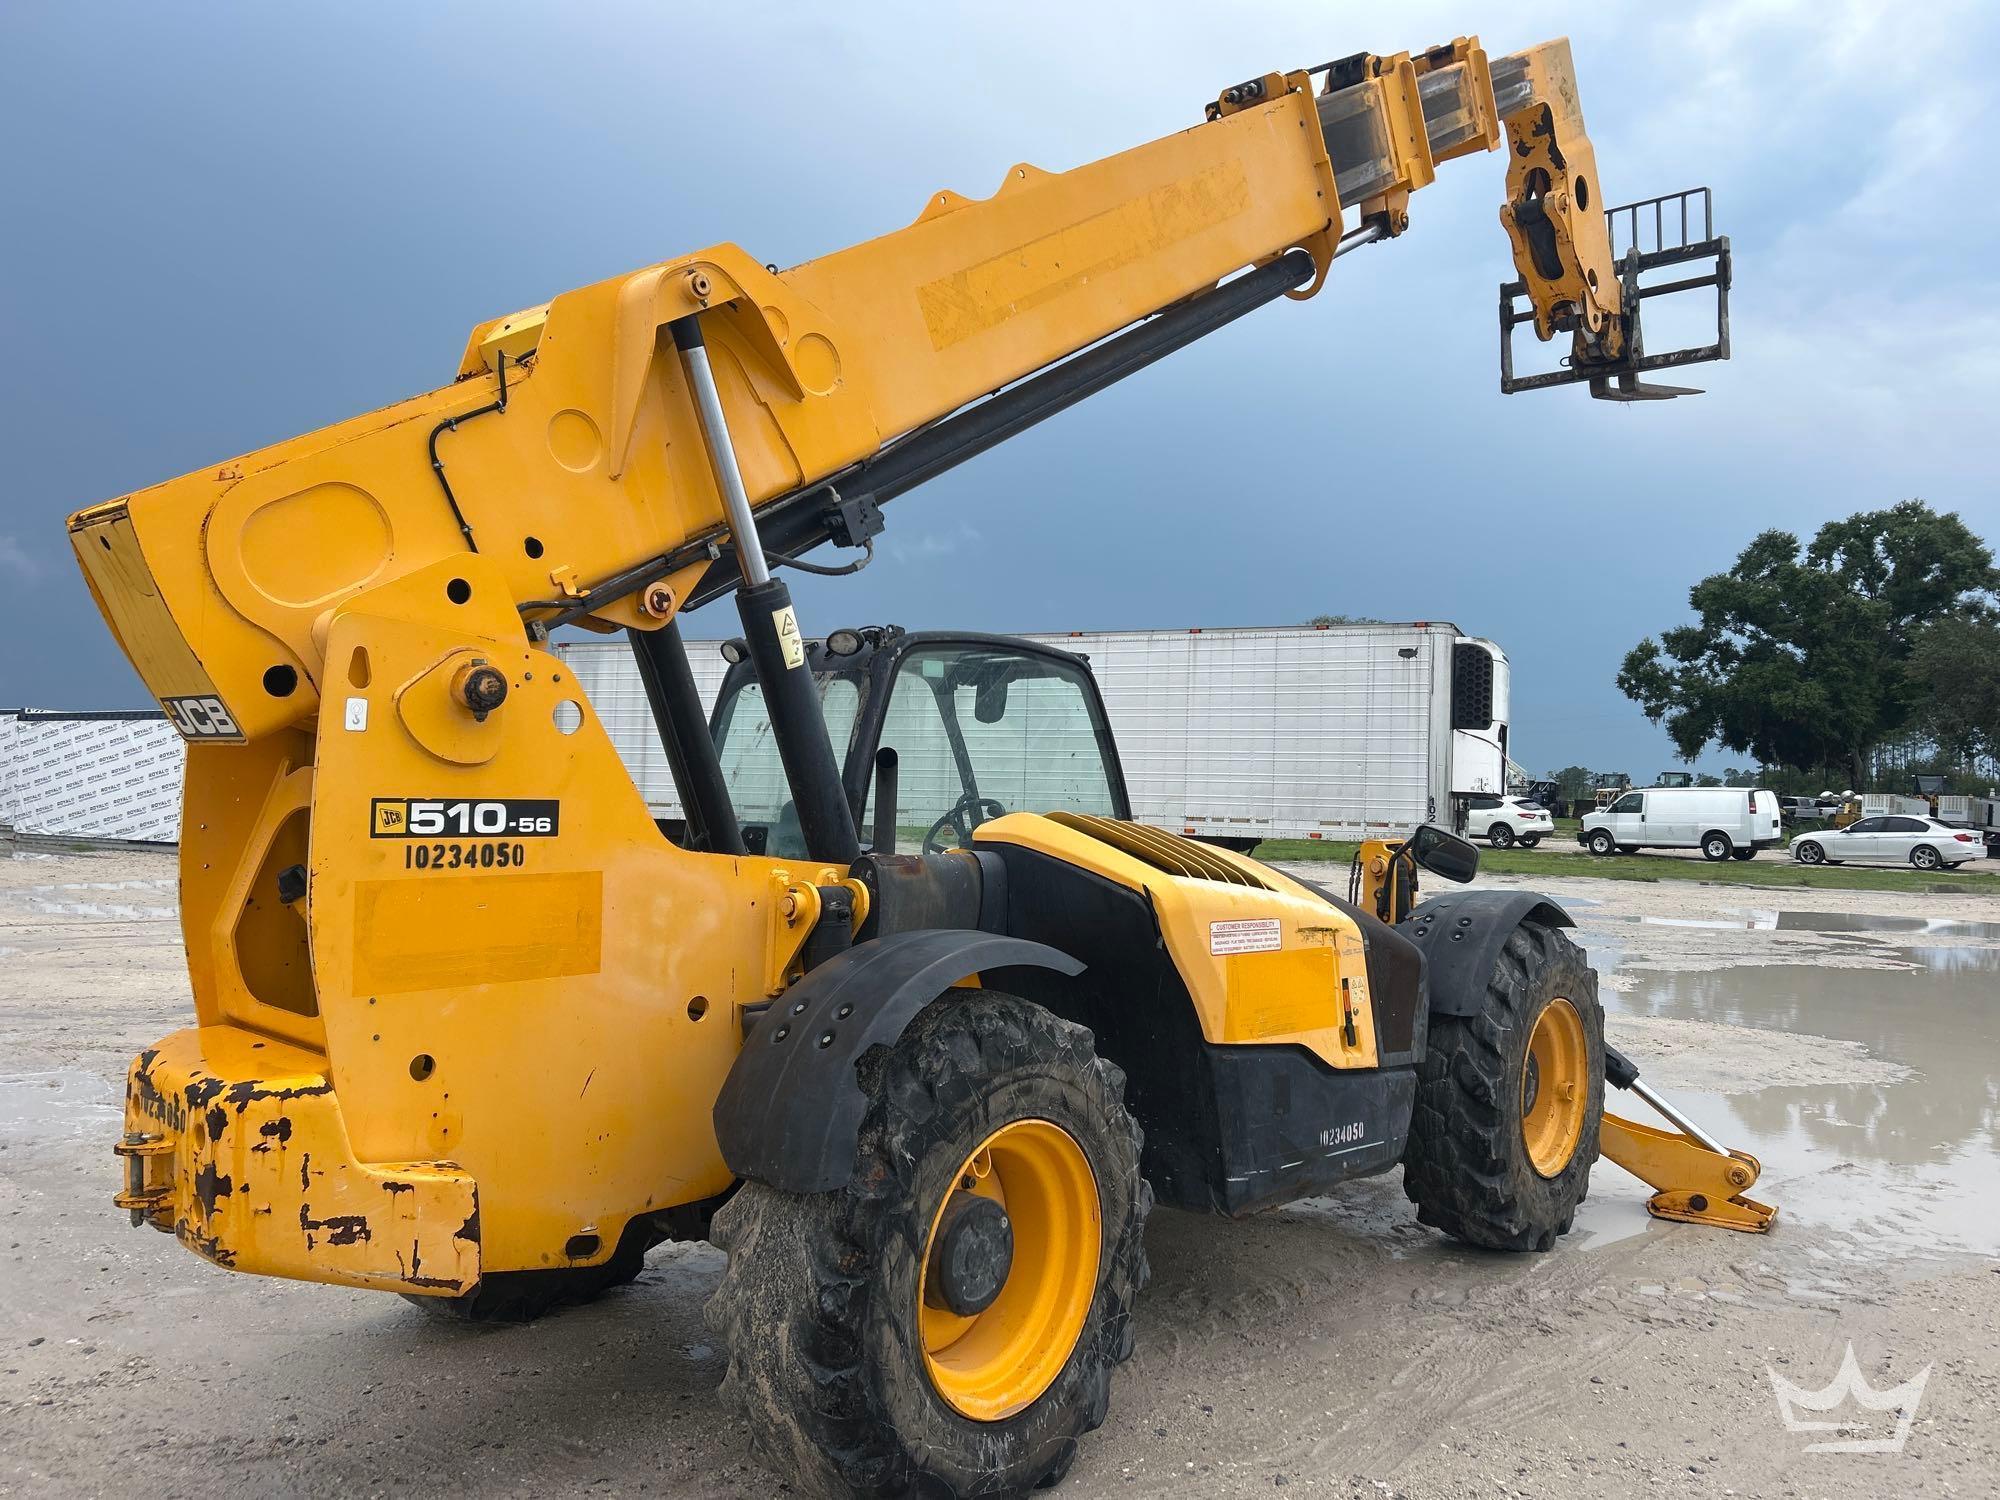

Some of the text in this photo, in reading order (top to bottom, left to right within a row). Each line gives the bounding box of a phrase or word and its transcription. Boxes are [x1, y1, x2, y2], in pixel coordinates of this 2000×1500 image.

[172, 699, 237, 734] JCB
[63, 722, 76, 730] ROYAL
[158, 720, 171, 728] ROYA
[42, 730, 56, 738] ROYAL
[75, 732, 89, 740] ROYAL
[134, 728, 148, 736] ROYAL
[54, 740, 67, 748] ROYAL
[110, 736, 124, 744] ROYAL
[146, 739, 161, 747] ROYAL
[32, 747, 46, 755] ROYAL
[86, 744, 100, 752] ROYAL
[64, 751, 77, 759] ROYAL
[99, 754, 114, 762] ROYAL
[159, 750, 174, 758] ROYAL
[44, 758, 57, 766] ROYAL
[112, 766, 126, 774] ROYAL
[148, 770, 164, 778] ROYAL
[383, 810, 401, 826] JCB
[406, 843, 524, 869] 10234050
[1320, 1122, 1364, 1146] 10234050
